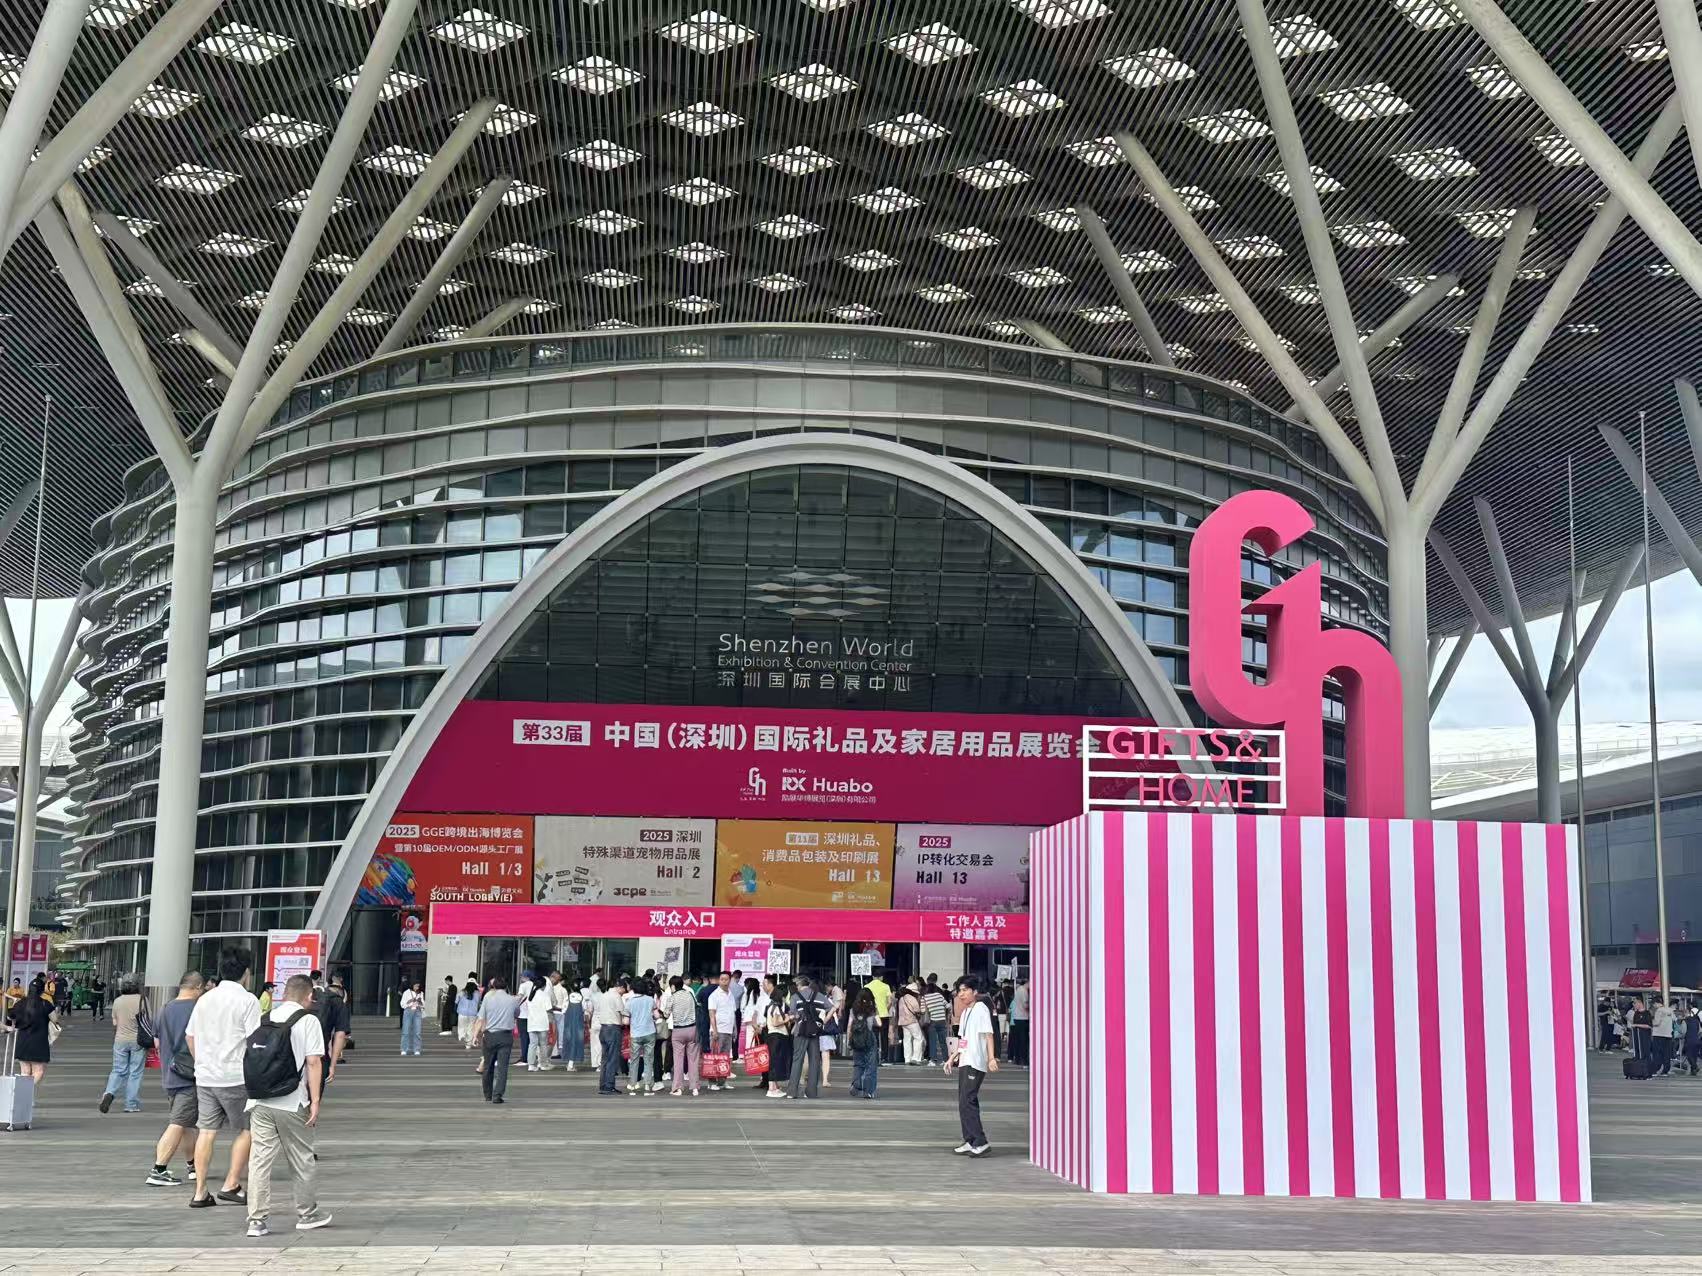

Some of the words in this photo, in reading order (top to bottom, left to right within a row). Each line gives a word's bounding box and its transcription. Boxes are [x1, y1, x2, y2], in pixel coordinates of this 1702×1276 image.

[719, 633, 832, 655] Shenzhen
[843, 636, 914, 657] World
[718, 655, 780, 668] Exhibition
[784, 657, 793, 668] &
[797, 657, 868, 671] Convention
[871, 659, 911, 672] Center
[718, 671, 911, 692] 深圳国际会展中心
[521, 722, 583, 743] 第33届
[782, 776, 807, 792] RX
[813, 777, 873, 793] Huabo
[1139, 773, 1256, 808] HOME
[389, 826, 416, 836] 2025
[422, 826, 524, 839] GGE跨境出海博览会
[643, 831, 670, 841] 2025
[676, 830, 702, 843] 深圳
[922, 837, 949, 847] 2025
[583, 846, 701, 861] 特殊渠道宠物用品展
[762, 849, 879, 865] 消费品包装及印刷展
[917, 853, 994, 866] IP转化交易会
[462, 862, 489, 875] Hall
[499, 863, 522, 876] 1/3
[657, 865, 683, 878] Hall
[692, 866, 701, 879] 2
[829, 869, 856, 883] Hall
[866, 870, 881, 883] 13
[916, 871, 942, 884] Hall
[952, 872, 968, 885] 13
[430, 892, 464, 902] SOUTH
[468, 893, 513, 903] LOBBY(E)
[649, 911, 715, 928] 观众入口
[946, 915, 1006, 928] 工作人员及
[950, 928, 999, 940] 特邀嘉宾
